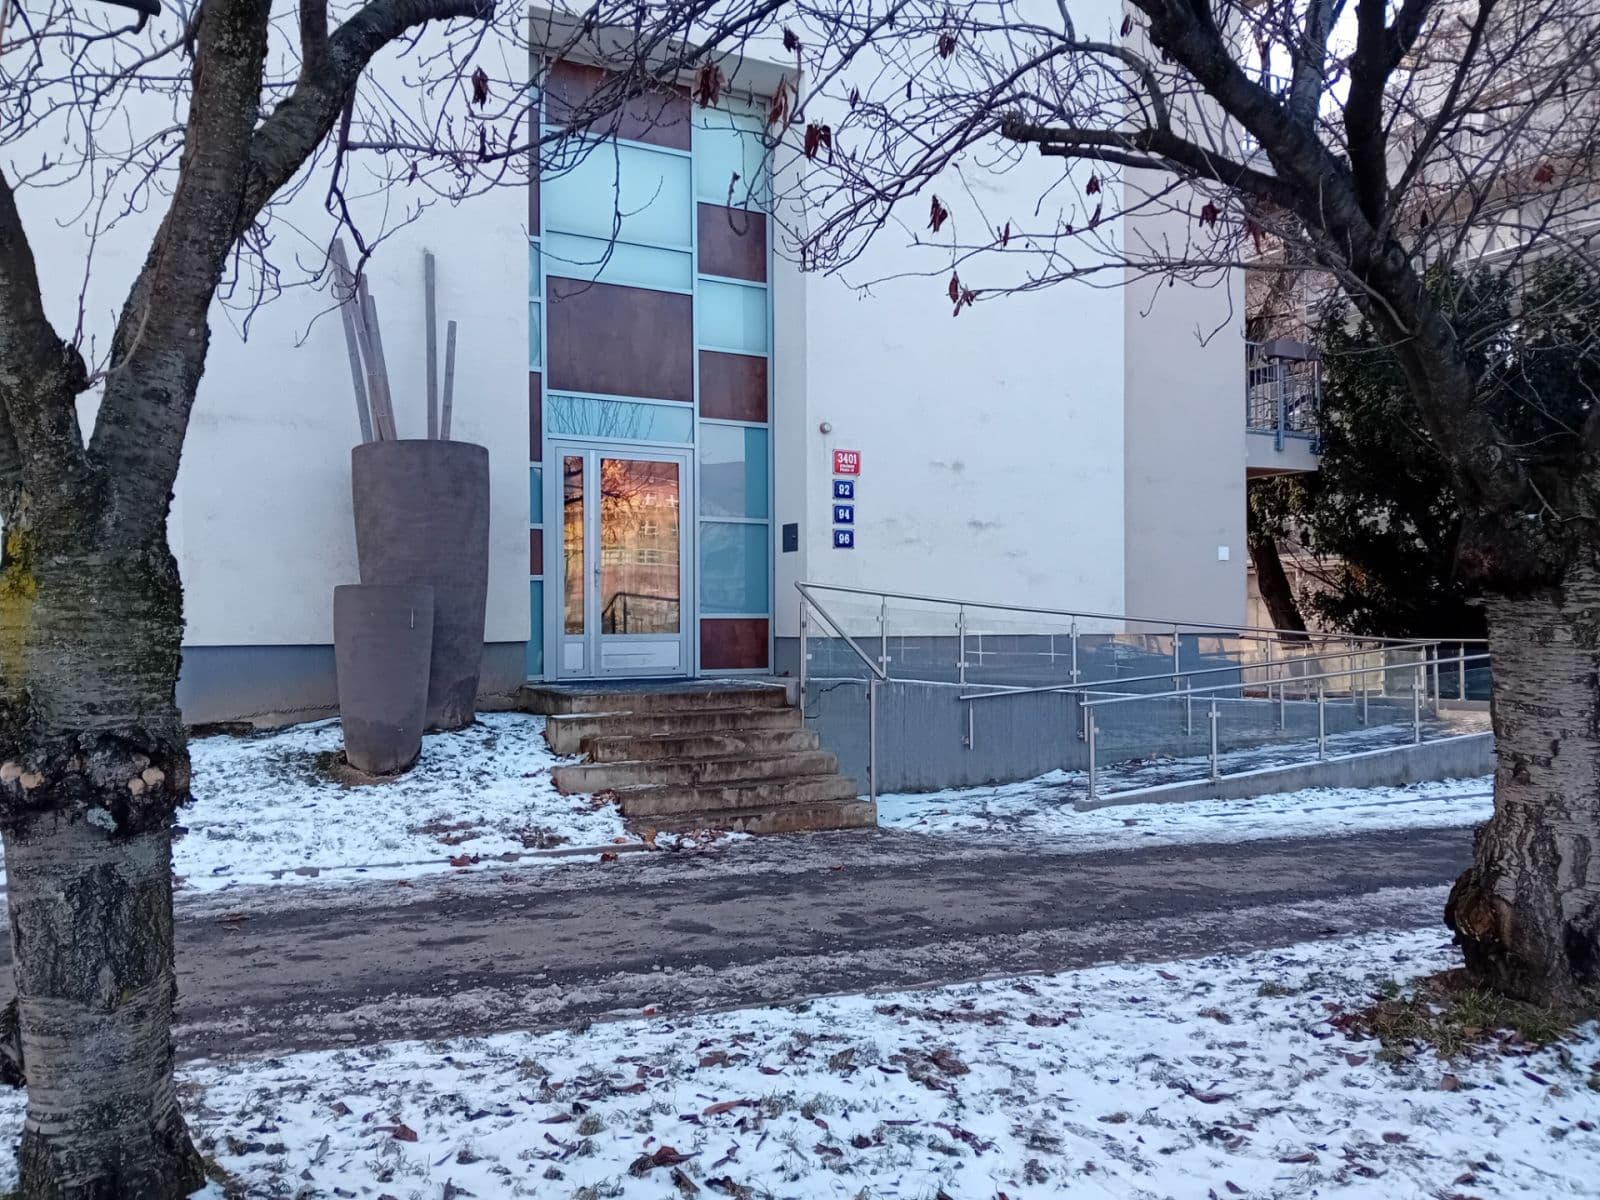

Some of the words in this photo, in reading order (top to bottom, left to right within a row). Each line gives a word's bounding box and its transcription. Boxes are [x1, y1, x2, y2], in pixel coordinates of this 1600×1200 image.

[837, 452, 857, 465] 3401
[838, 484, 850, 496] 92
[838, 509, 850, 520] 94
[838, 533, 850, 544] 96
